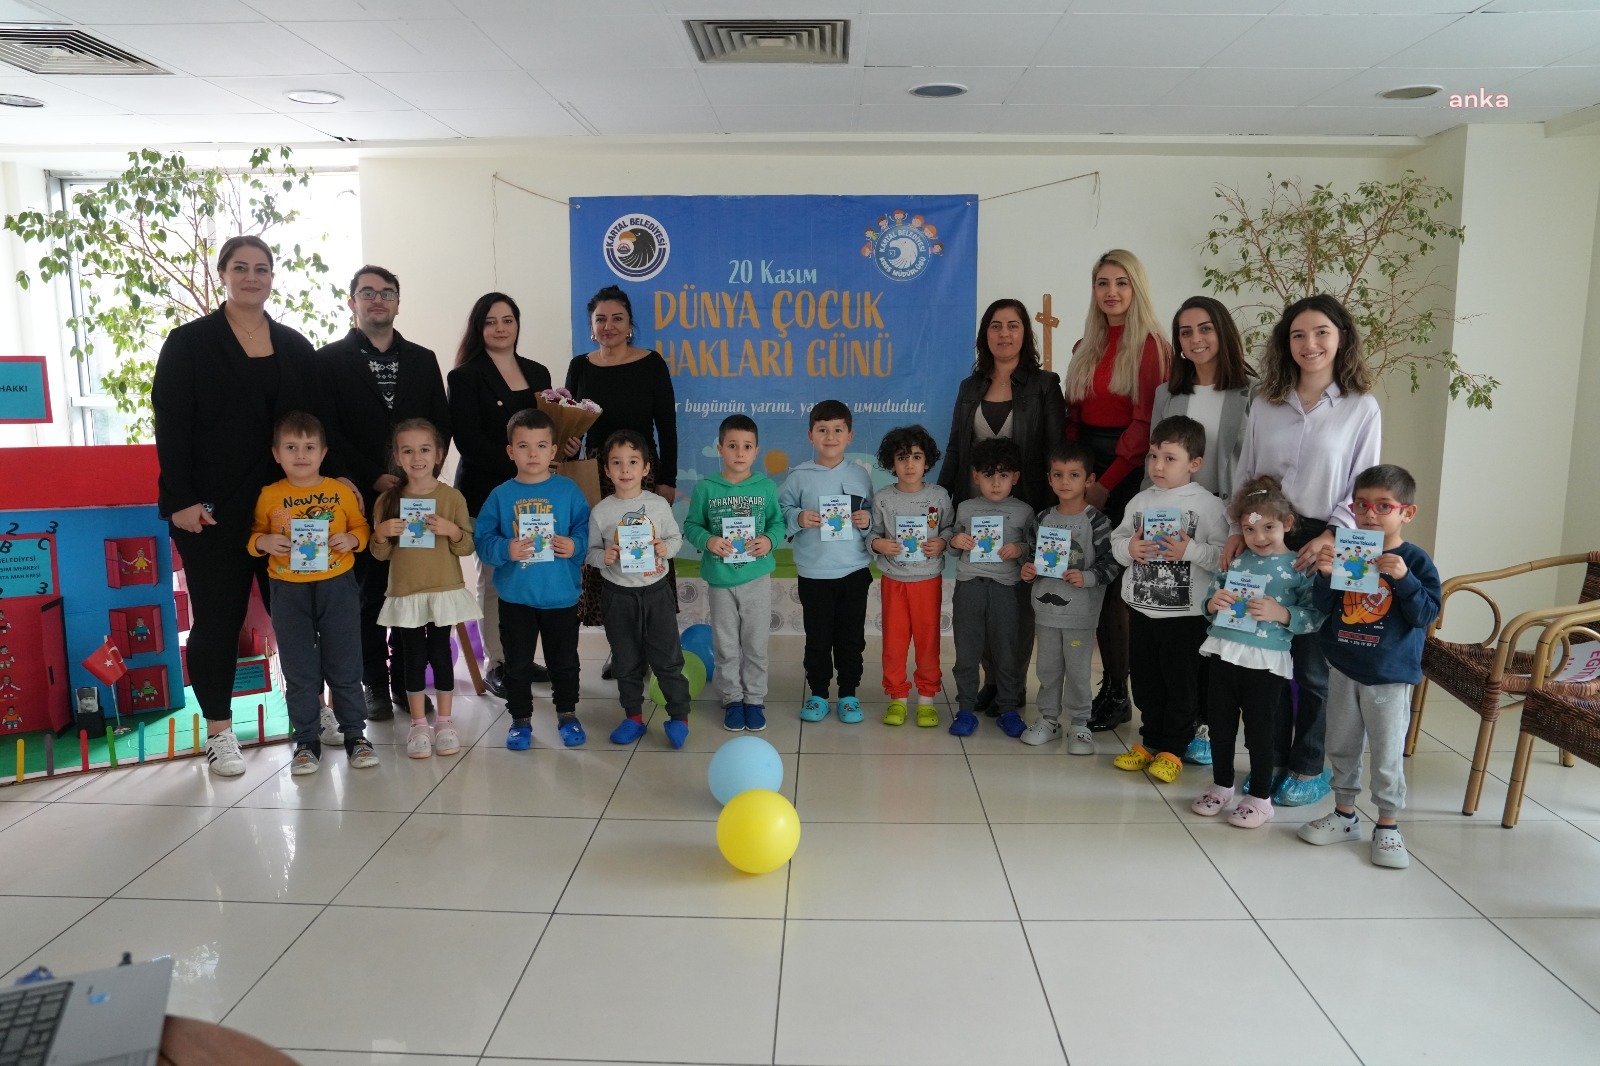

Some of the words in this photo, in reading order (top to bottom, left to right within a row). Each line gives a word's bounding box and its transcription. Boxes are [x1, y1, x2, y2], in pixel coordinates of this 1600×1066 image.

[606, 221, 629, 247] KARTAL
[629, 218, 667, 246] BELEDİYESİ
[728, 259, 753, 284] 20
[654, 283, 760, 330] DÜNYA
[772, 290, 884, 338] ÇOCUK
[806, 332, 892, 377] GÜNÜ
[685, 399, 747, 417] bugünün
[853, 399, 926, 413] umududur.
